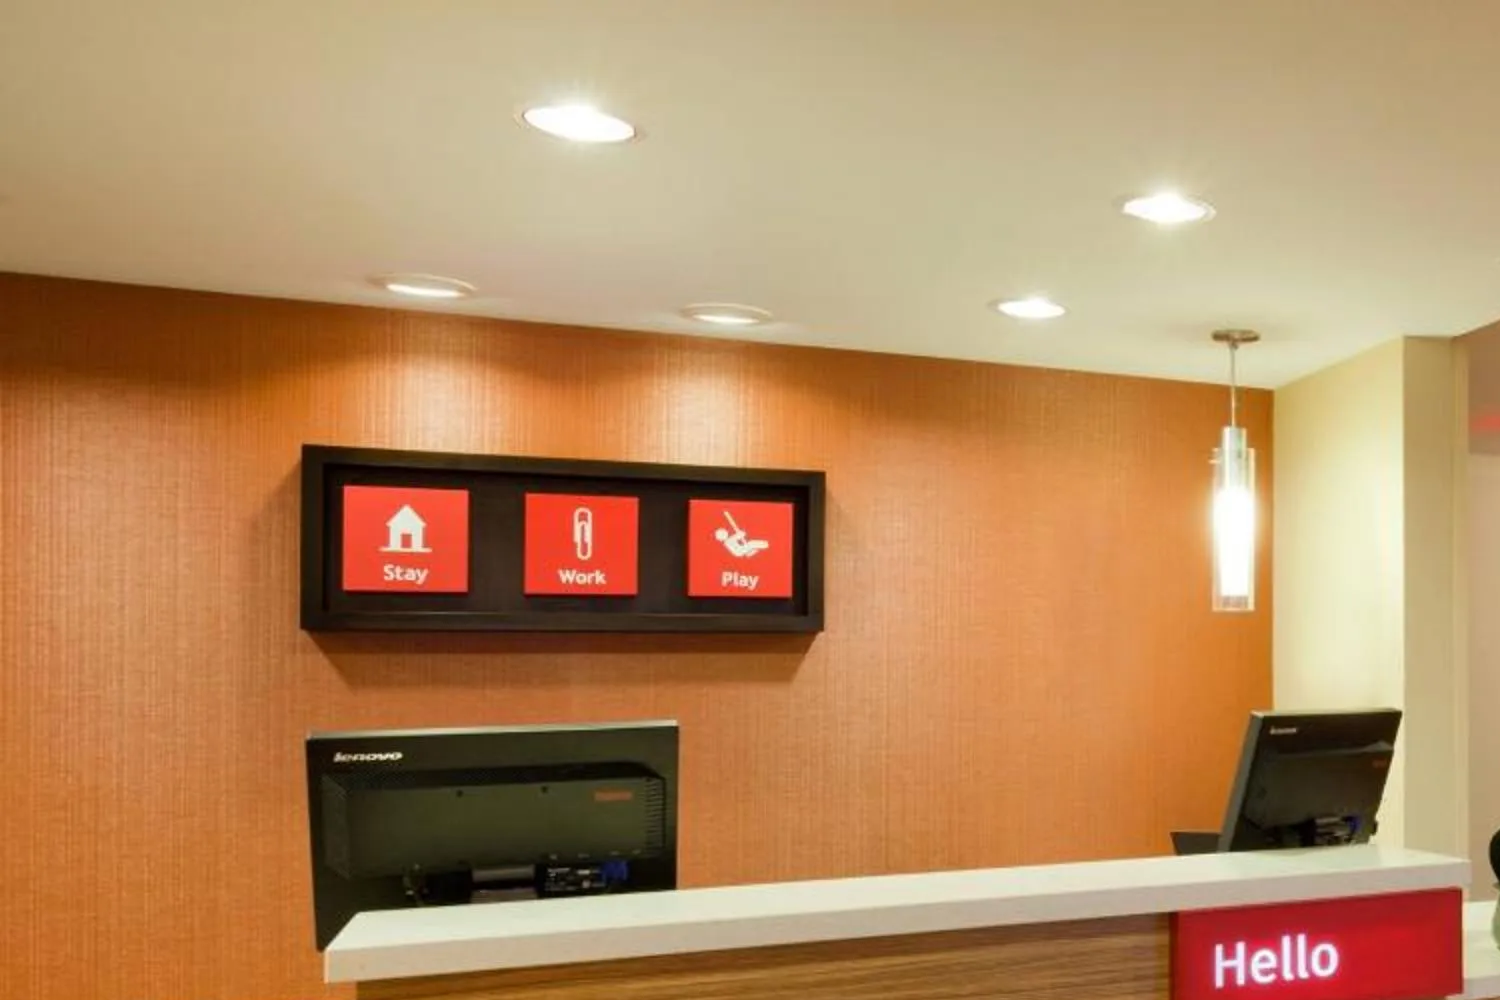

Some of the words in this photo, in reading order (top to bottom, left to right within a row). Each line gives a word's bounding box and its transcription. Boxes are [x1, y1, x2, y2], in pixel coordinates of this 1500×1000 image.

[383, 563, 429, 585] Stay
[558, 568, 606, 586] Work
[721, 570, 760, 590] Play
[333, 751, 404, 763] lenovo
[1214, 932, 1340, 989] Hello
